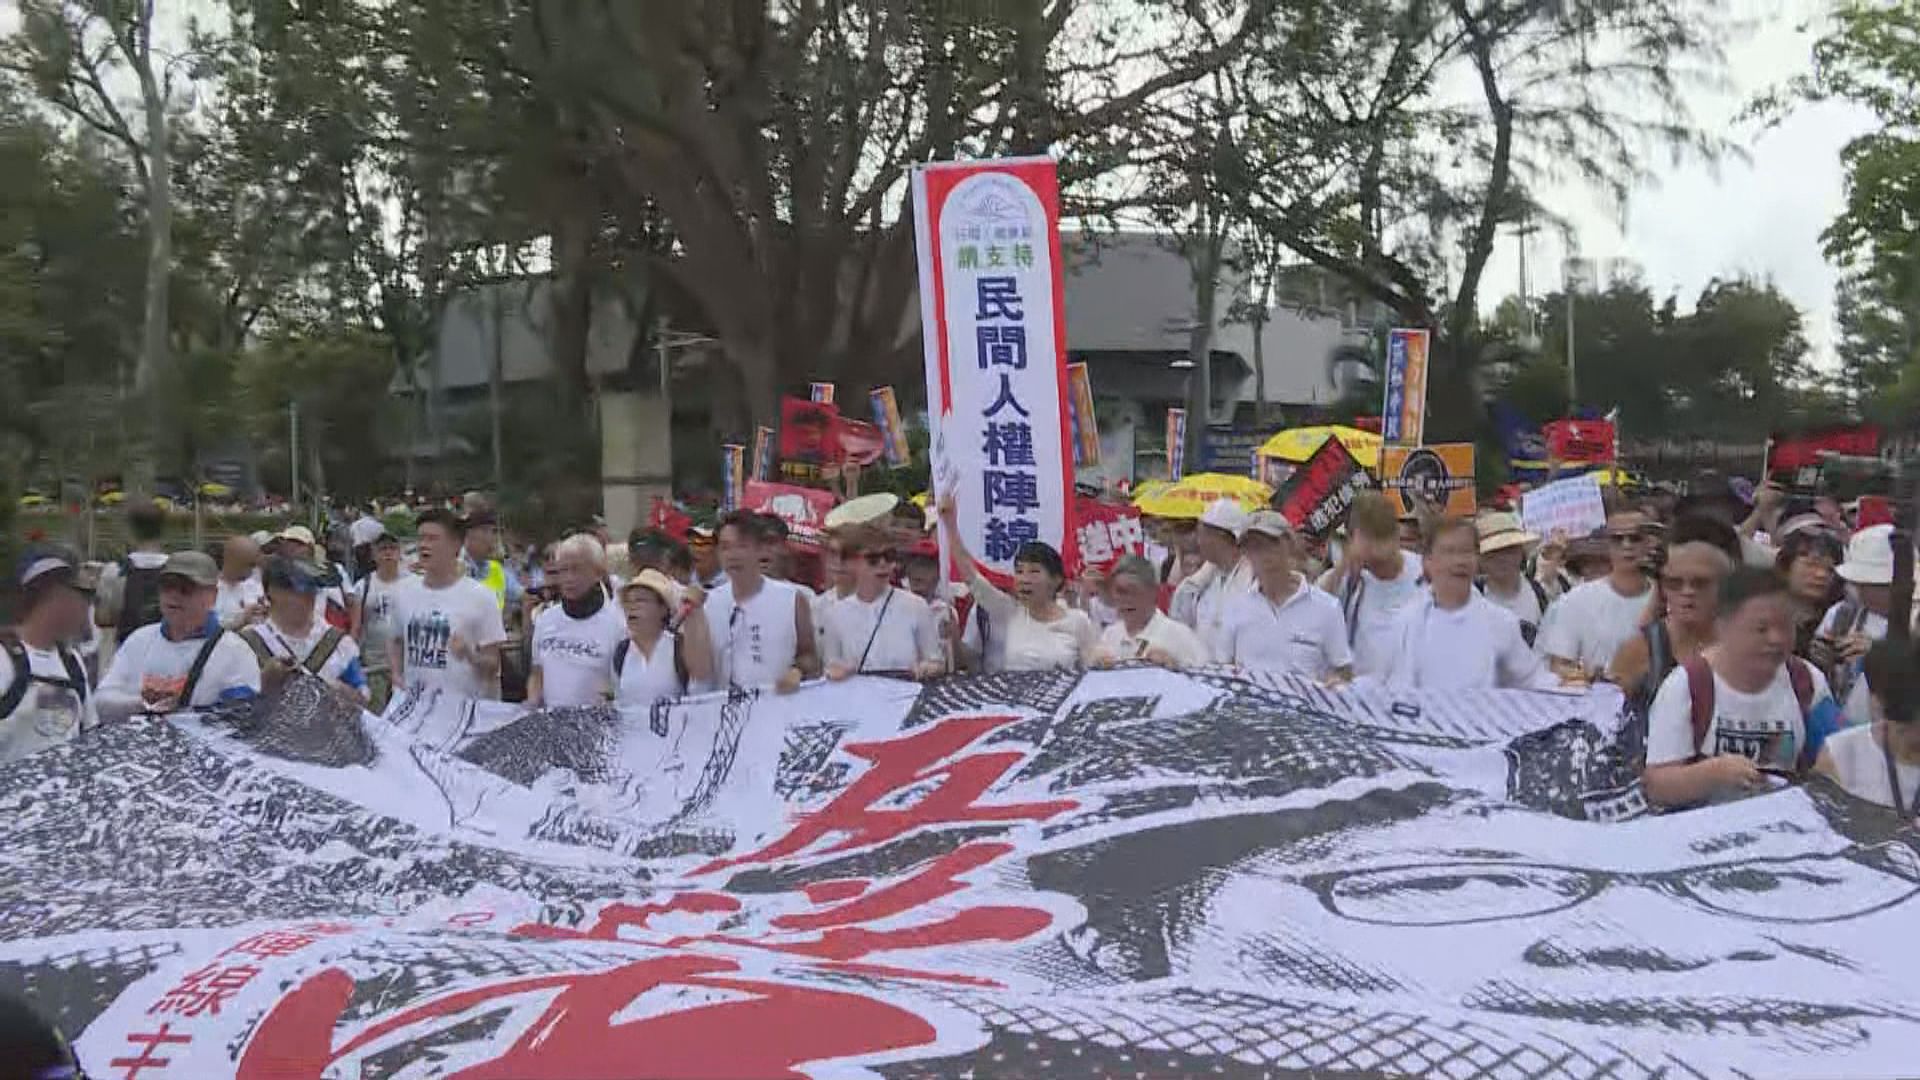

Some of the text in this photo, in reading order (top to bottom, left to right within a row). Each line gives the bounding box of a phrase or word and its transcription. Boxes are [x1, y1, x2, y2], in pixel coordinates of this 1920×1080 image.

[976, 276, 1041, 562] 民間人權陣線
[110, 922, 352, 1080] 陣線主
